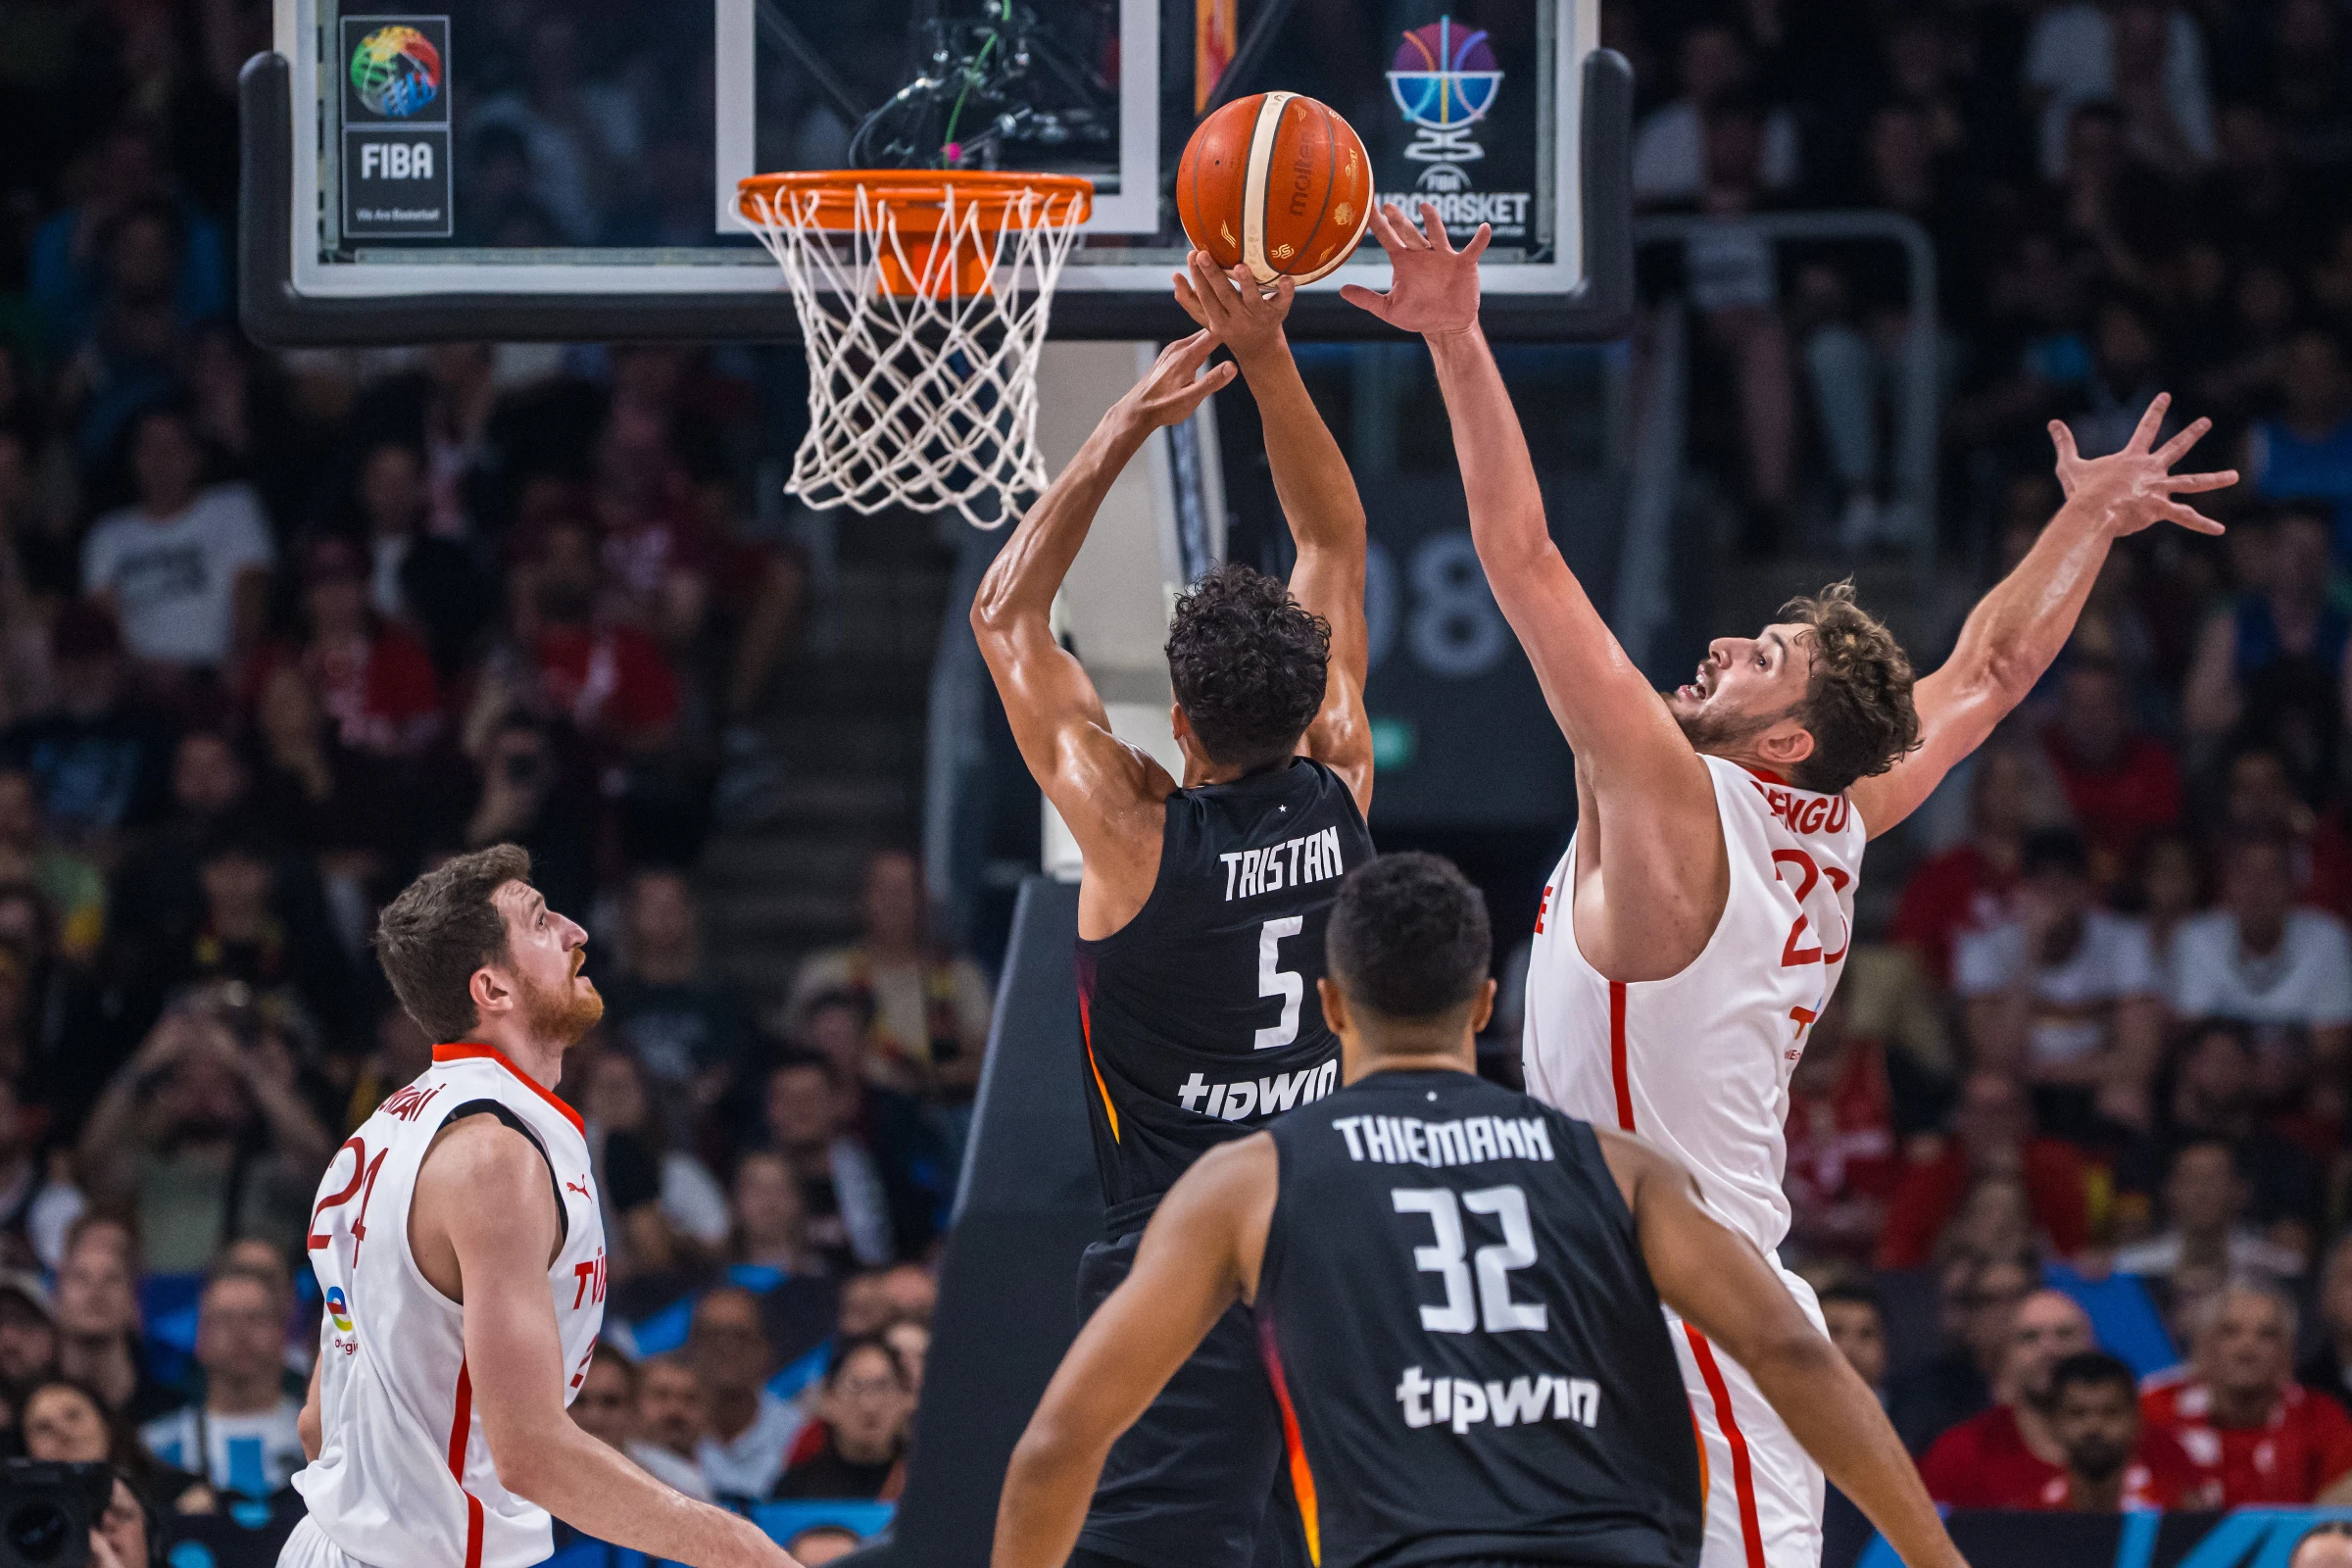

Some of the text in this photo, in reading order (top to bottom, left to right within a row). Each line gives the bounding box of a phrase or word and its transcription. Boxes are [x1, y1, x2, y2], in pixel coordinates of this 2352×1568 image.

[361, 141, 433, 180] FIBA
[1289, 132, 1315, 217] molten
[1373, 192, 1531, 224] ROBASKET
[1219, 825, 1344, 902] TRISTAN
[1253, 915, 1304, 1051] 5
[1178, 1058, 1338, 1123] tipwin
[1332, 1114, 1556, 1169] THIEMANN
[1390, 1184, 1549, 1335] 32
[1396, 1365, 1602, 1435] tipwin
